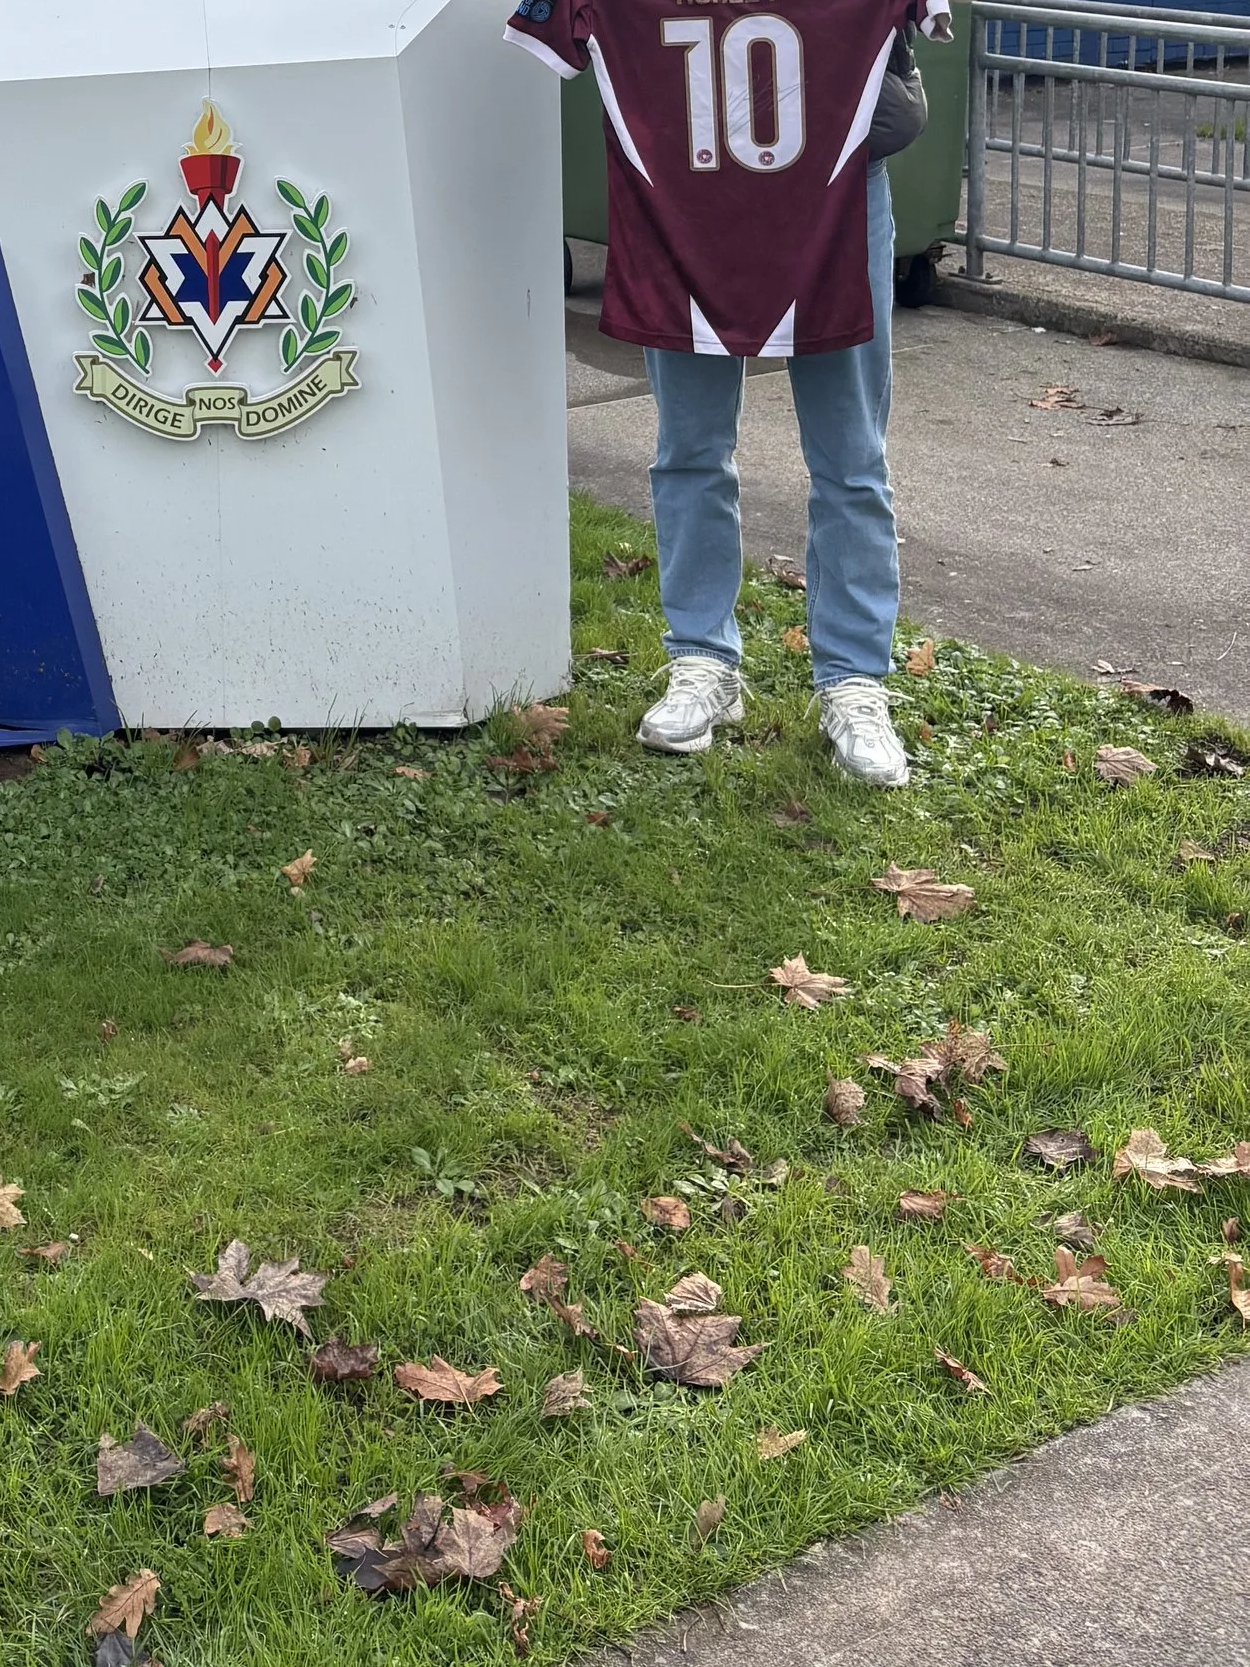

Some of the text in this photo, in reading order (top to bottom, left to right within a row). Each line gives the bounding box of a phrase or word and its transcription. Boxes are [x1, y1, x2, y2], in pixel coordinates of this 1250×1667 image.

[660, 12, 806, 173] 10
[111, 374, 328, 429] DIRIGE NOS DOMINE
